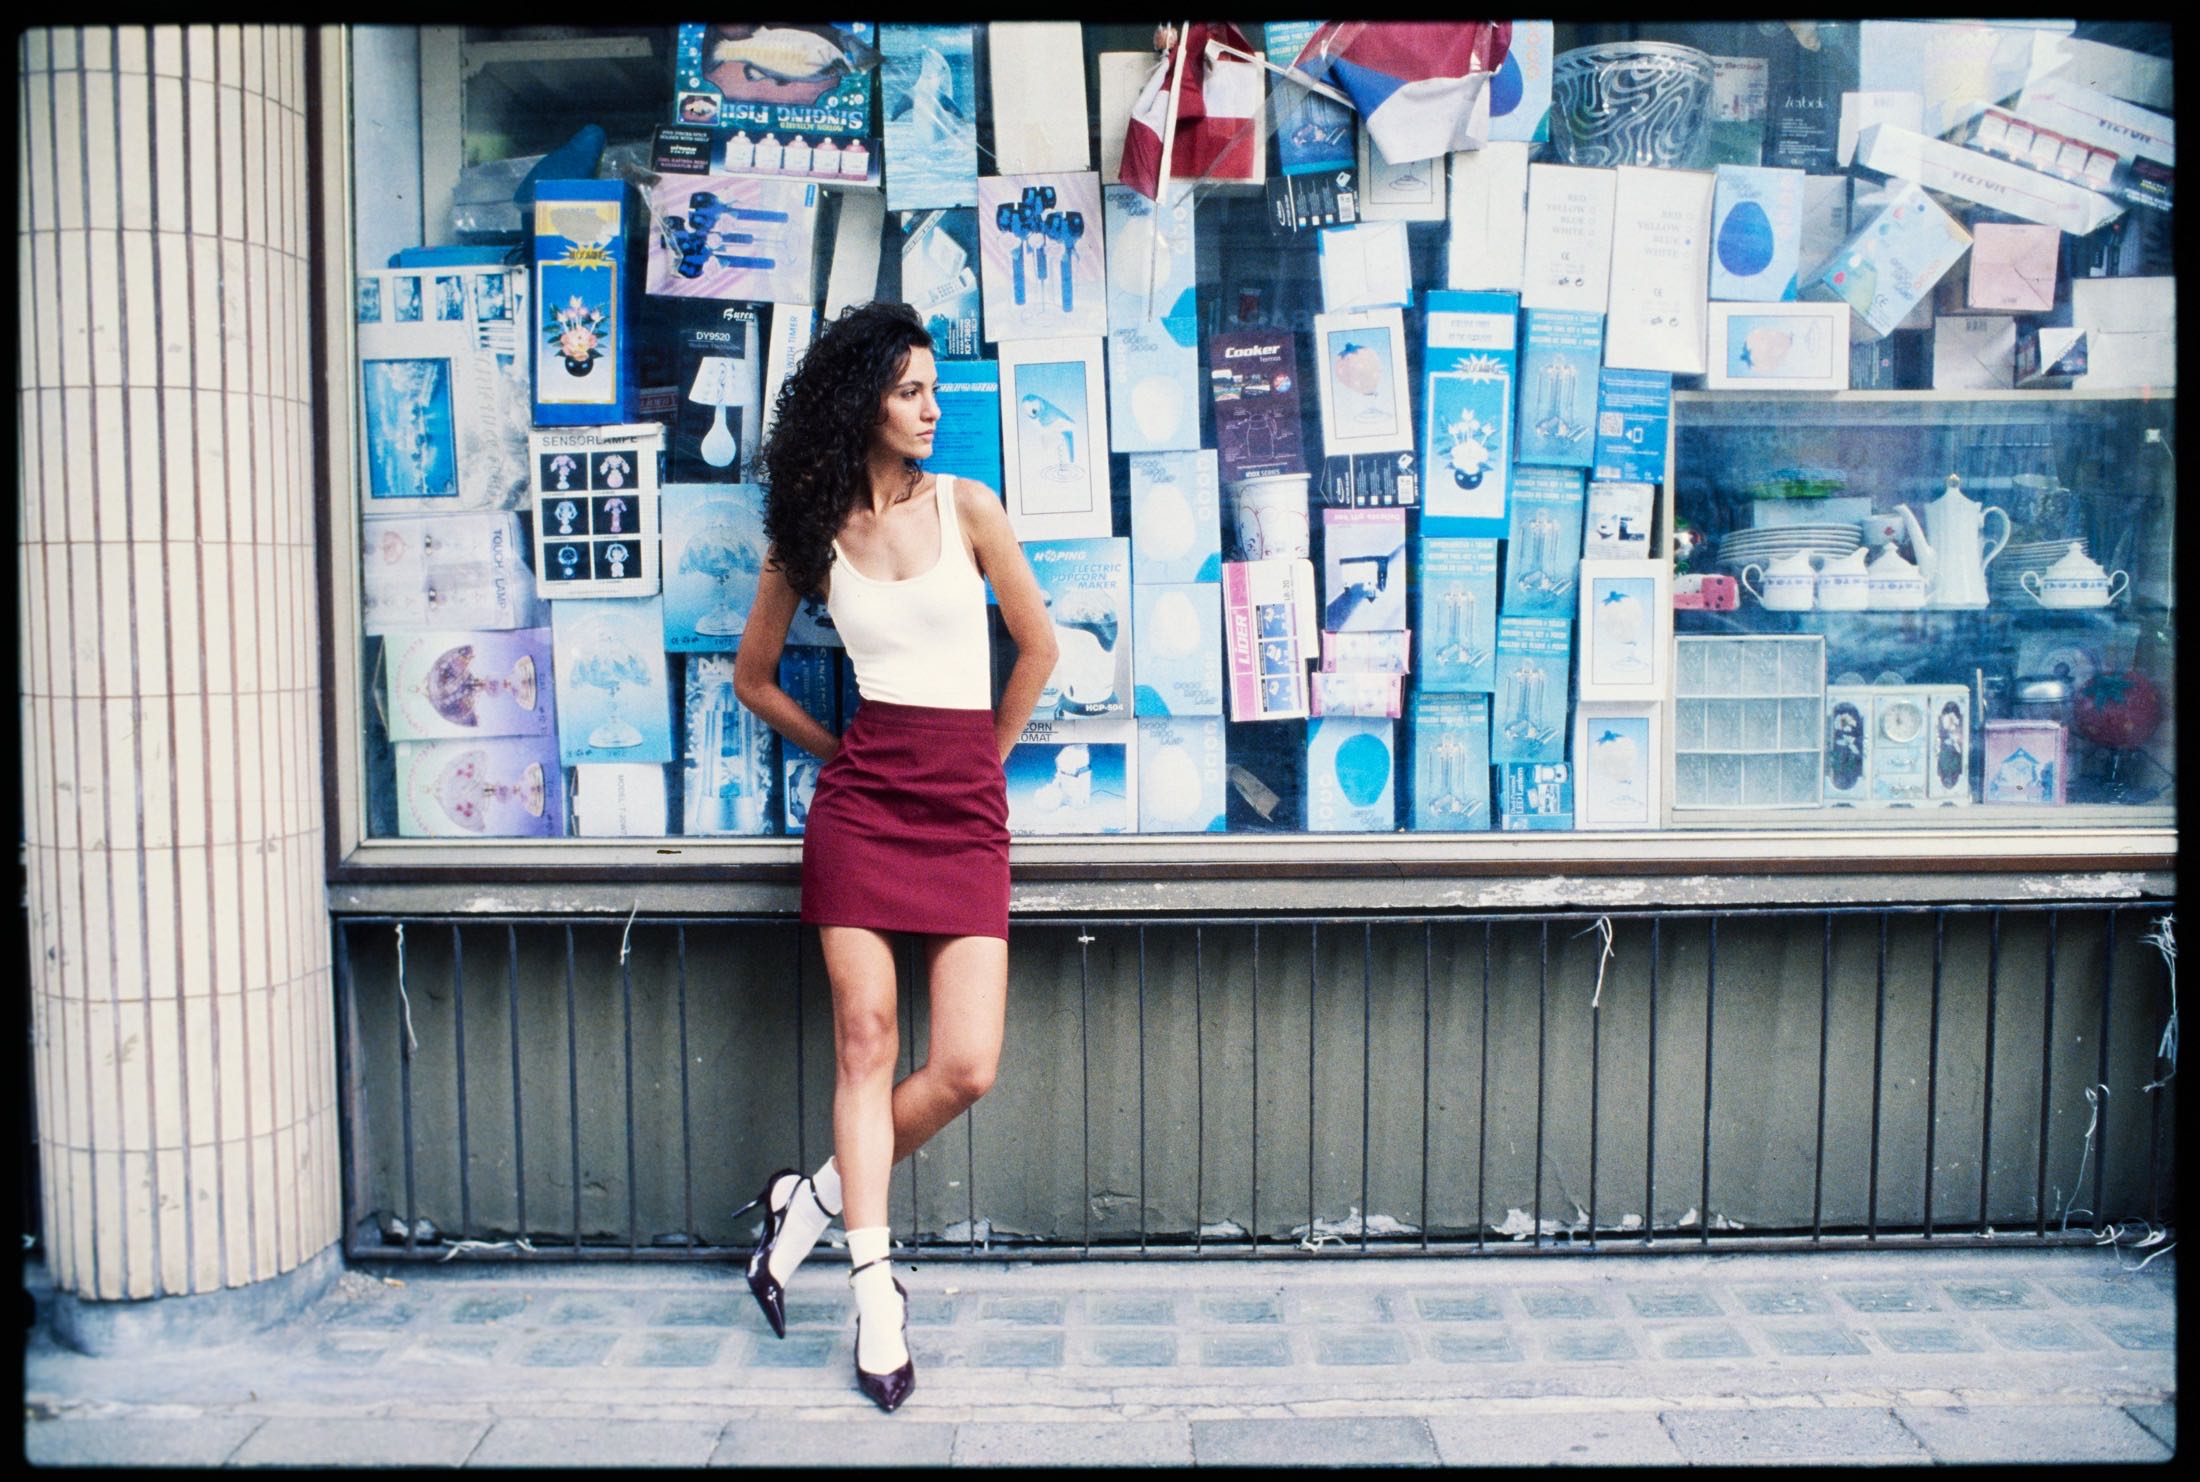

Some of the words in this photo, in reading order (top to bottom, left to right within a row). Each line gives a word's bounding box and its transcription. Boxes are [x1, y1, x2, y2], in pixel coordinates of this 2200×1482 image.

[777, 106, 864, 130] SINGING
[787, 315, 799, 343] TIMER
[696, 331, 731, 342] DY9520
[1224, 344, 1281, 359] Cooker
[542, 435, 639, 447] SENSORLAMPE
[493, 528, 504, 569] TOUCH
[1072, 563, 1122, 574] ELECTRIC
[1051, 573, 1107, 584] POPCORN
[1078, 580, 1117, 590] MAKER
[495, 578, 507, 609] LAMP
[817, 648, 828, 713] SINGING
[1085, 703, 1124, 712] HCP-504
[1024, 722, 1052, 732] CORN
[1020, 733, 1052, 742] OMAT
